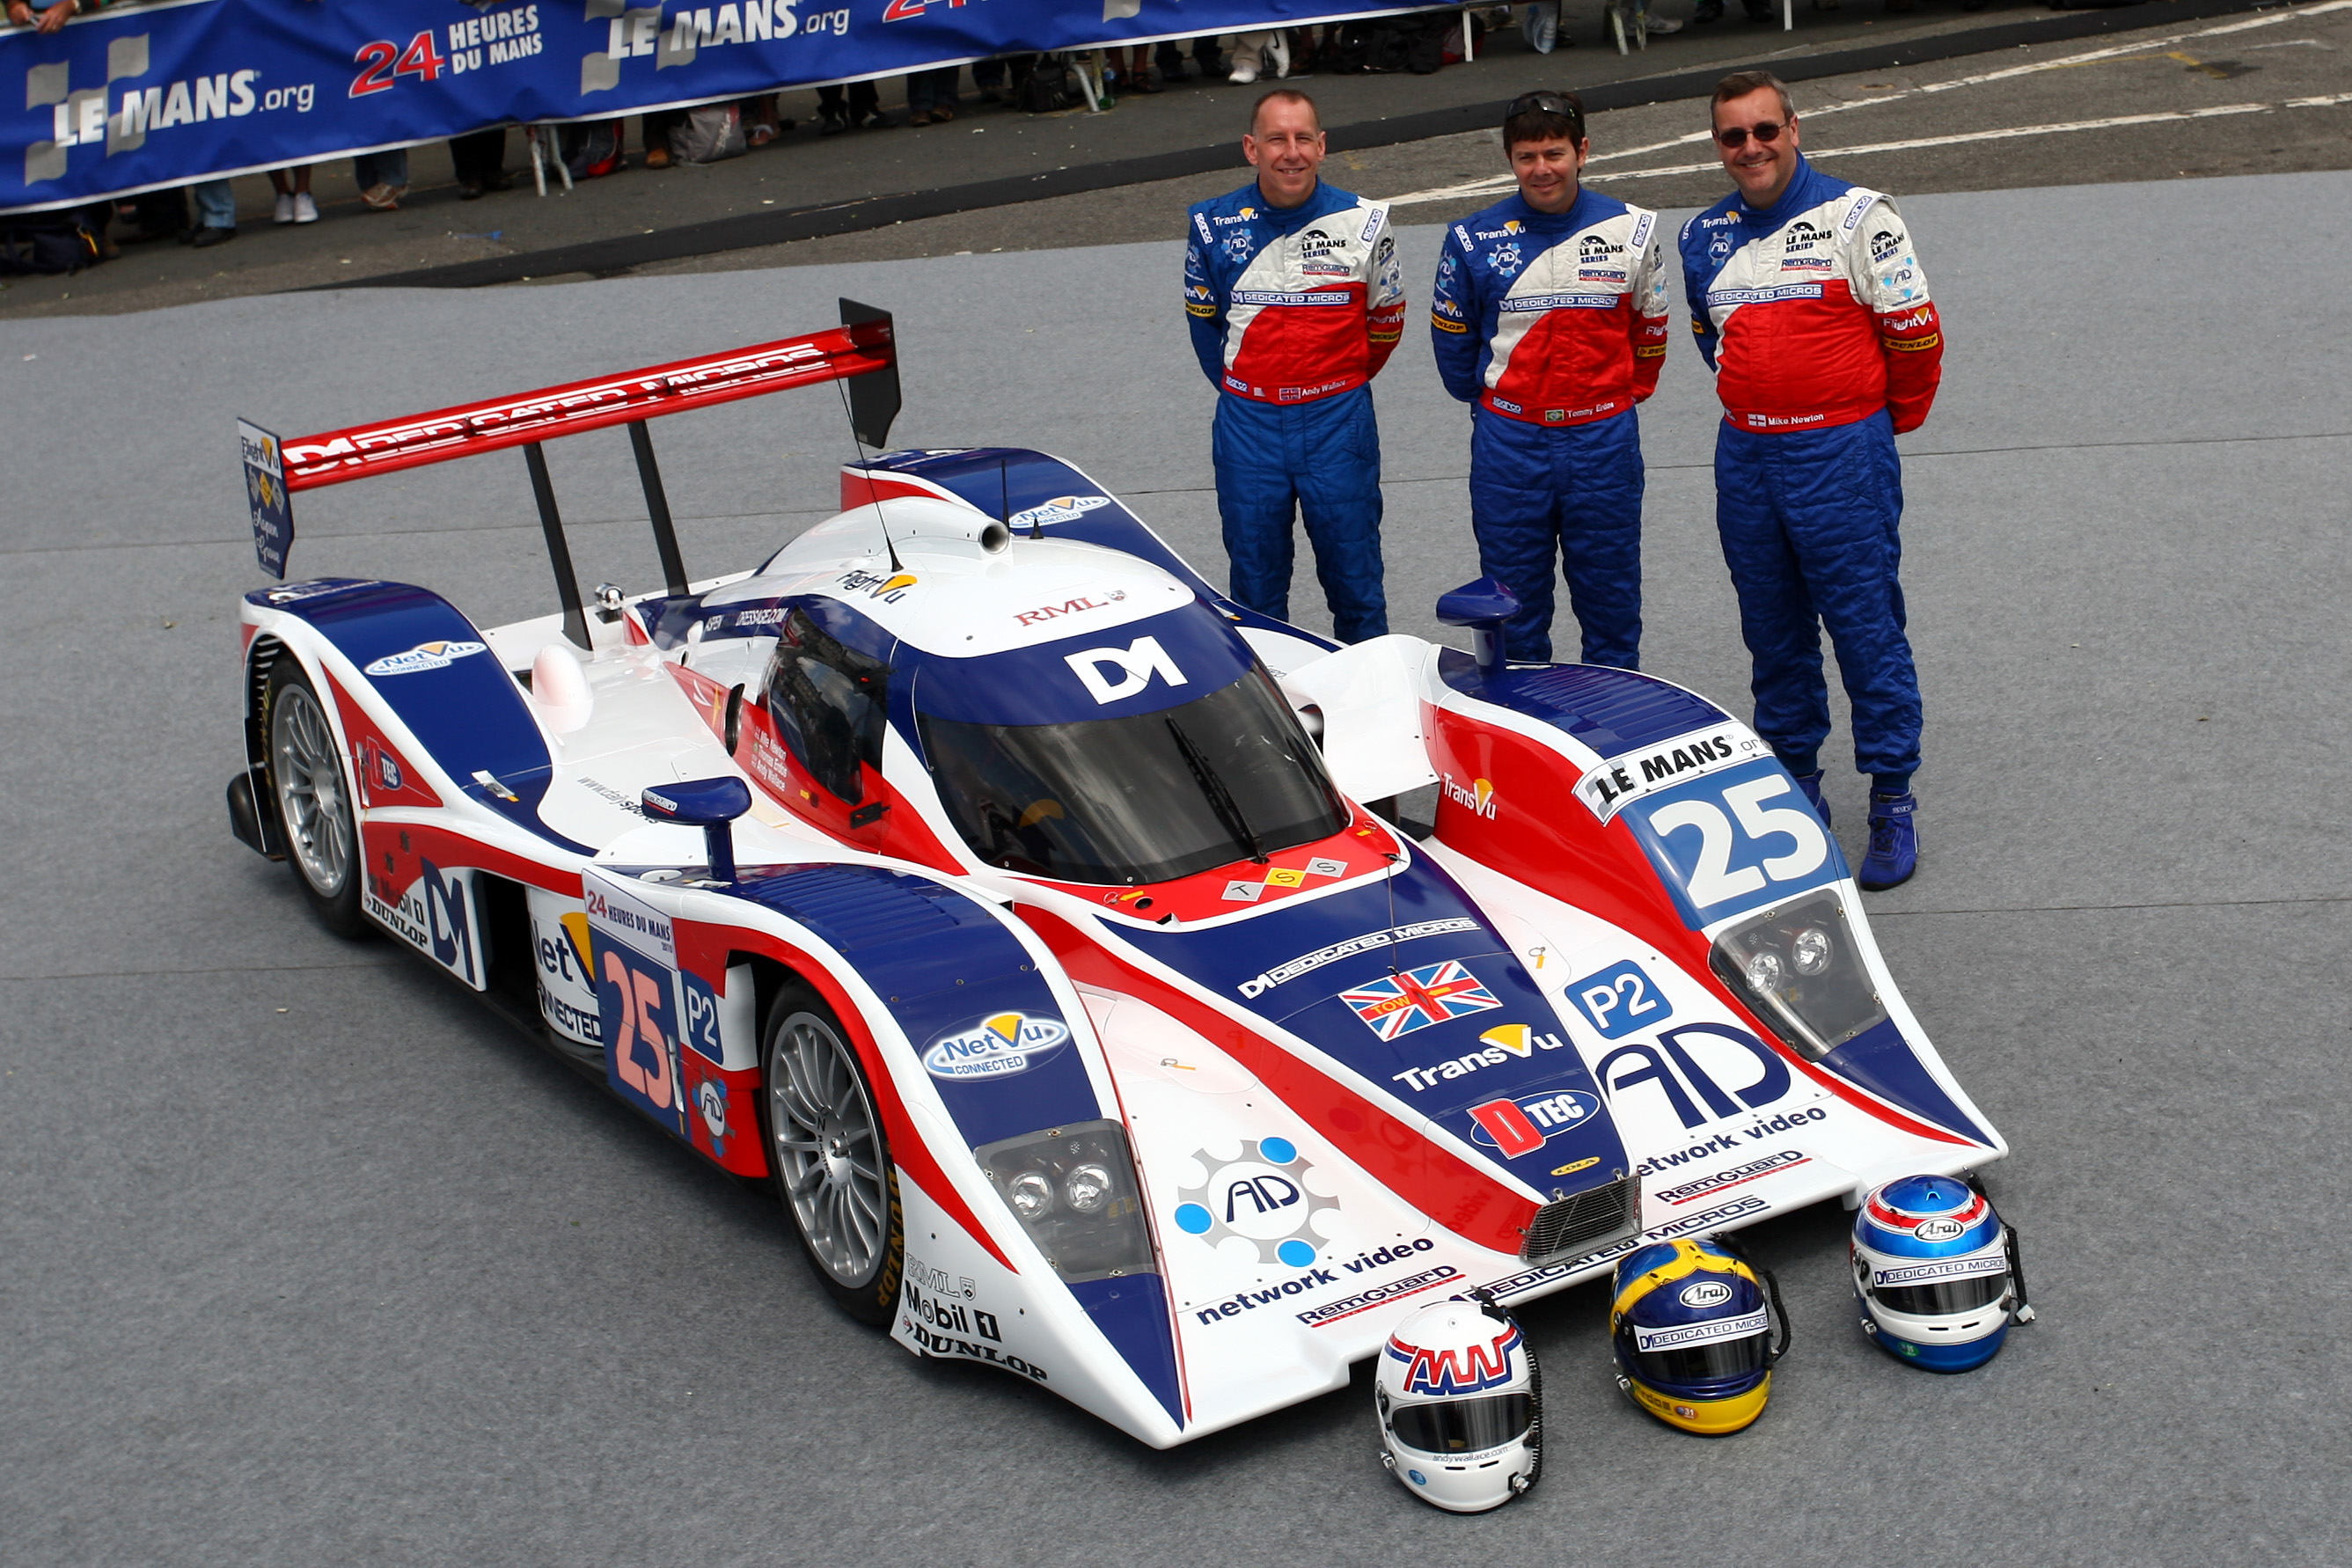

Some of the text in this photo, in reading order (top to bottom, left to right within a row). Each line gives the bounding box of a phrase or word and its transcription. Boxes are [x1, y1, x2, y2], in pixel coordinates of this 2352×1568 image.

[449, 6, 539, 51] HEURES
[609, 17, 655, 60] LE
[348, 30, 444, 98] 24
[452, 33, 543, 74] DU MANS
[54, 99, 106, 148] LE
[1213, 207, 1258, 226] TransVu
[1476, 221, 1526, 240] TransVu
[1301, 239, 1346, 252] LE MANS
[1302, 248, 1330, 259] SERIES
[1594, 245, 1623, 253] MANS
[1785, 242, 1814, 253] SERIES
[1786, 230, 1833, 245] LE MANS
[1872, 245, 1885, 257] LE
[1497, 253, 1515, 263] AD
[1244, 294, 1305, 303] DEDICATED
[1513, 297, 1574, 307] DEDICATED
[1577, 296, 1617, 304] MICROS
[1715, 291, 1774, 301] DEDICATED
[1777, 286, 1822, 296] MICROS
[1890, 337, 1936, 349] DUNLOP
[1301, 380, 1345, 396] Andy Wallace
[1567, 409, 1593, 418] Tommy
[1768, 414, 1824, 426] Mike Newton
[1022, 498, 1090, 522] NetVu
[836, 569, 918, 605] FlightVu
[1013, 597, 1110, 626] RML
[382, 642, 465, 668] NetVu
[1595, 767, 1634, 804] LE
[1639, 736, 1733, 782] MANS
[1443, 772, 1497, 820] TransVu
[1649, 773, 1828, 909] 25
[372, 898, 428, 948] DUNLOP
[588, 890, 670, 942] 24 HEURES DU MANS
[1269, 934, 1390, 983] DEDICATED
[1395, 920, 1478, 939] MICROS
[687, 985, 717, 1047] P2
[1369, 996, 1411, 1015] TOW
[1581, 973, 1657, 1029] P2
[604, 950, 671, 1109] 25
[943, 1015, 1043, 1061] NetVu
[956, 1056, 1024, 1074] CONNECTED
[1392, 1024, 1564, 1092] TransVu
[1595, 1022, 1791, 1129] AD
[1637, 1107, 1827, 1176] etwork video
[1226, 1176, 1301, 1223] AD
[877, 1167, 904, 1308] DUNLOP
[906, 1253, 961, 1298] RML
[1197, 1238, 1434, 1326] network video
[1887, 1262, 1965, 1280] DEDICATED
[1967, 1258, 2004, 1270] MICROS
[905, 1279, 1002, 1343] Mobil 1
[1652, 1323, 1733, 1345] DEDICATED
[1735, 1315, 1767, 1330] MICROS
[913, 1323, 1048, 1381] DUNLOP
[1432, 1447, 1508, 1462] andywallace.com
